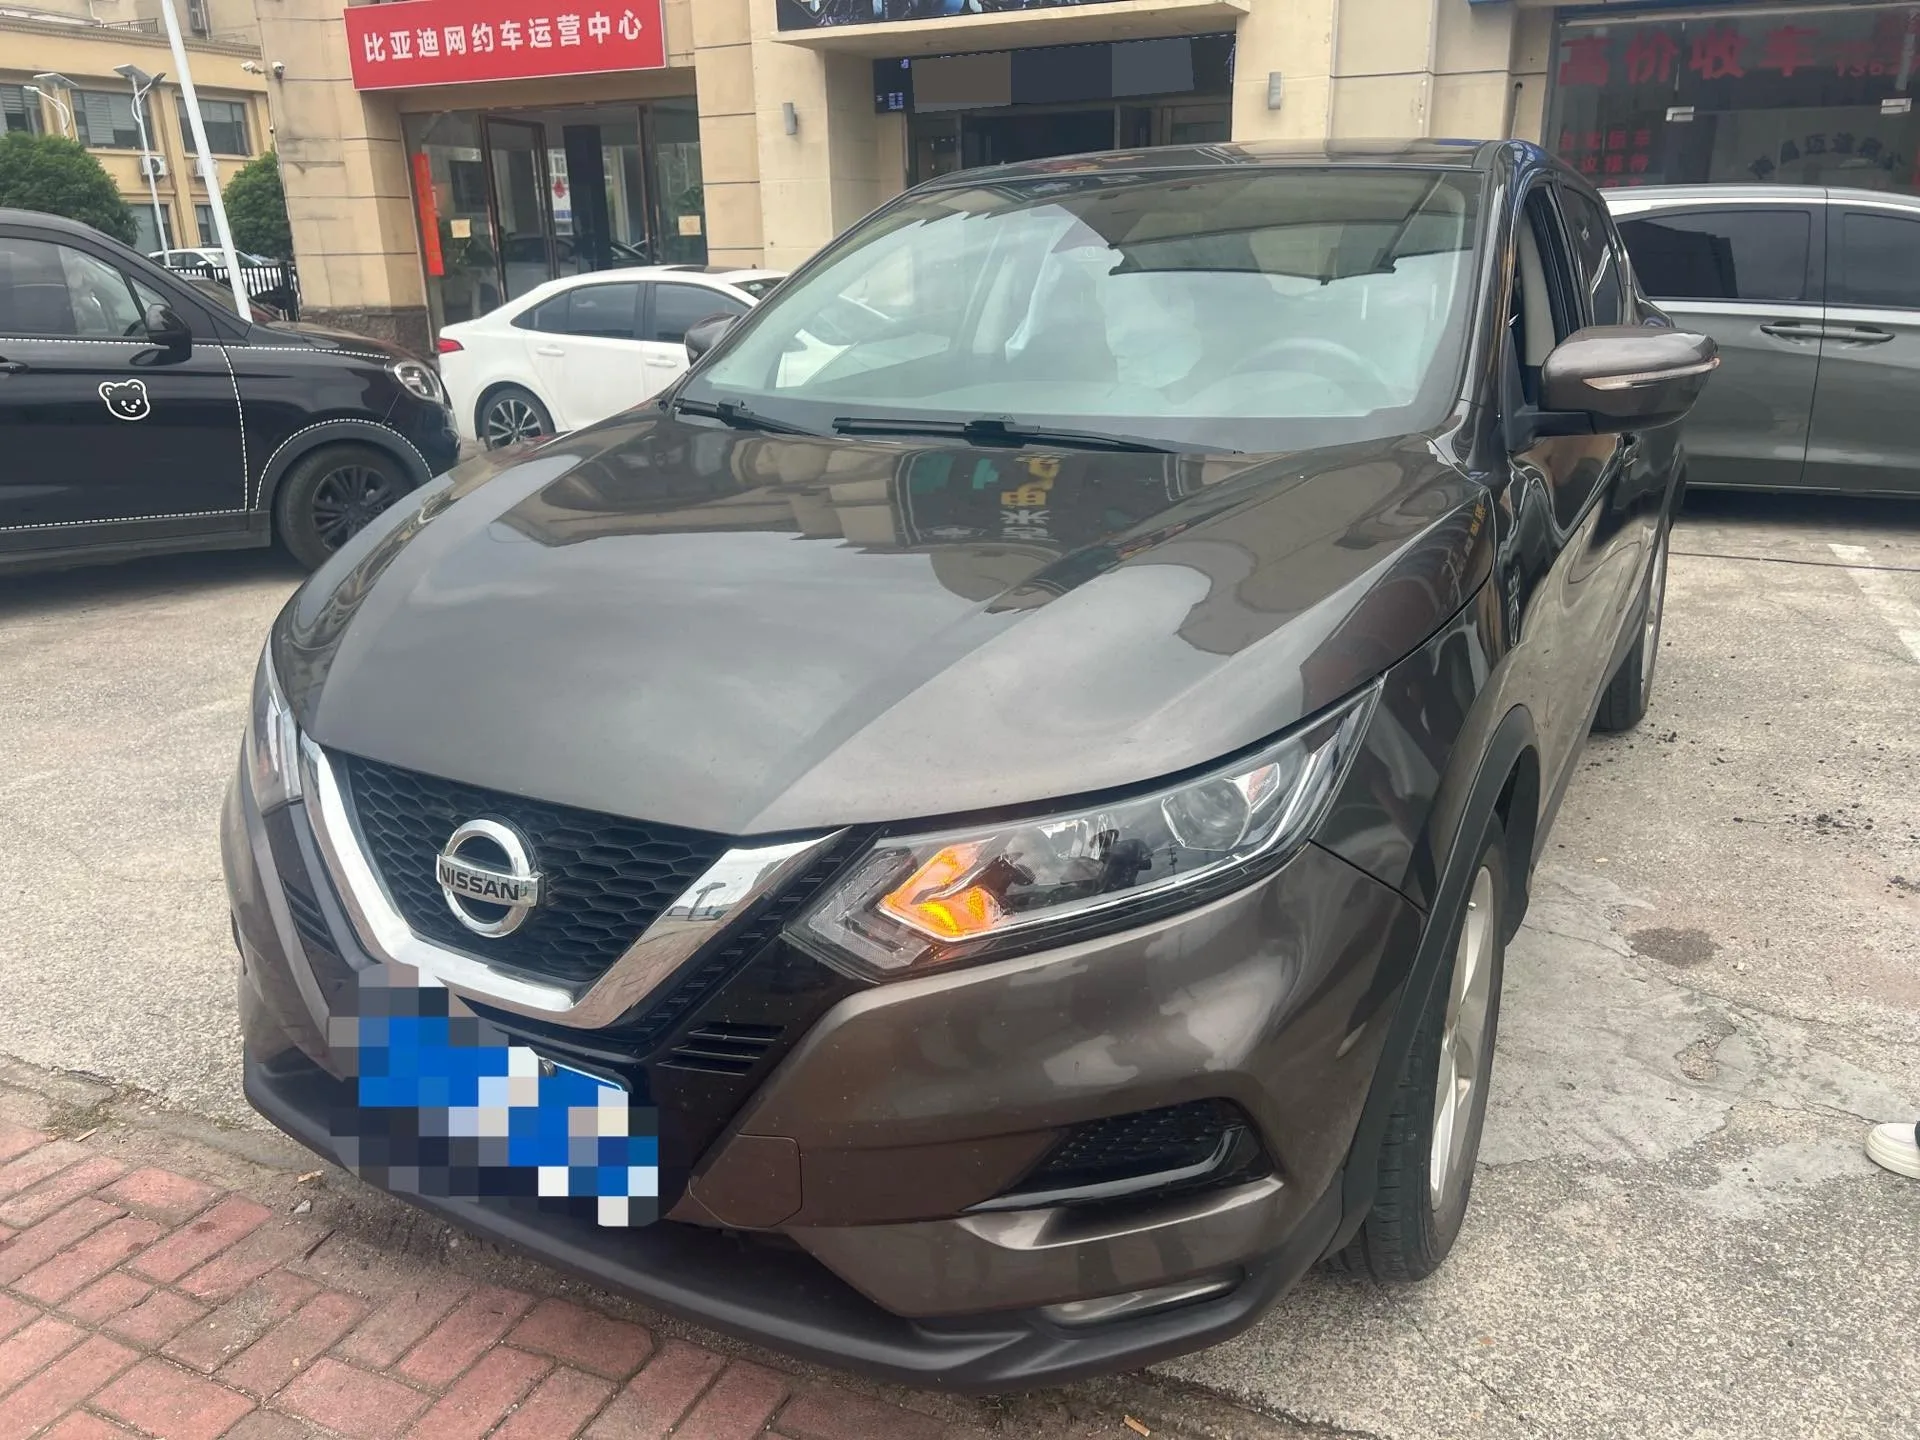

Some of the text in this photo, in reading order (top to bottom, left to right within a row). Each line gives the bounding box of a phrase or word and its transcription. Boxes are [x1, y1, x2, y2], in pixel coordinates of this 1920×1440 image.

[362, 9, 643, 63] 比亚迪网约车运营中心
[1558, 24, 1820, 86] 高价收车
[439, 863, 520, 901] NISSAN
